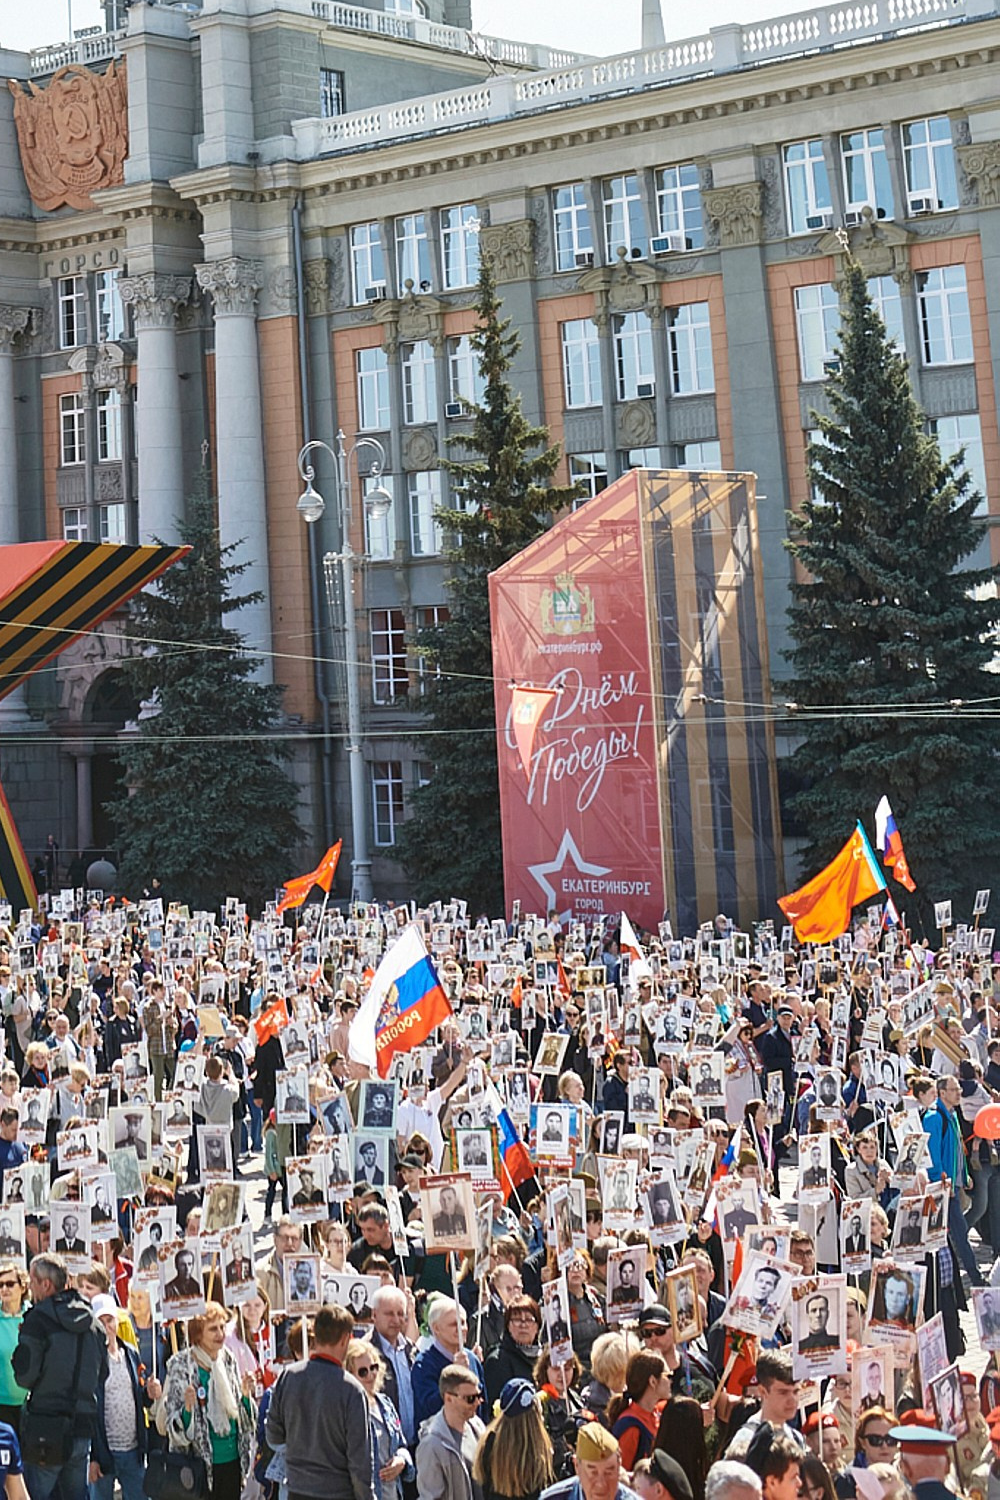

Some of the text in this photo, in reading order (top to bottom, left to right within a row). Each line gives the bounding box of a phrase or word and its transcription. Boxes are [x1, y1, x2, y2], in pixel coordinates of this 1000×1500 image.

[544, 668, 638, 732] Днём
[518, 705, 644, 812] Победы!
[562, 878, 651, 896] ЕКАТЕРИНБУРГ
[575, 898, 604, 911] ГОРОД
[576, 912, 621, 924] ТРУОЙ
